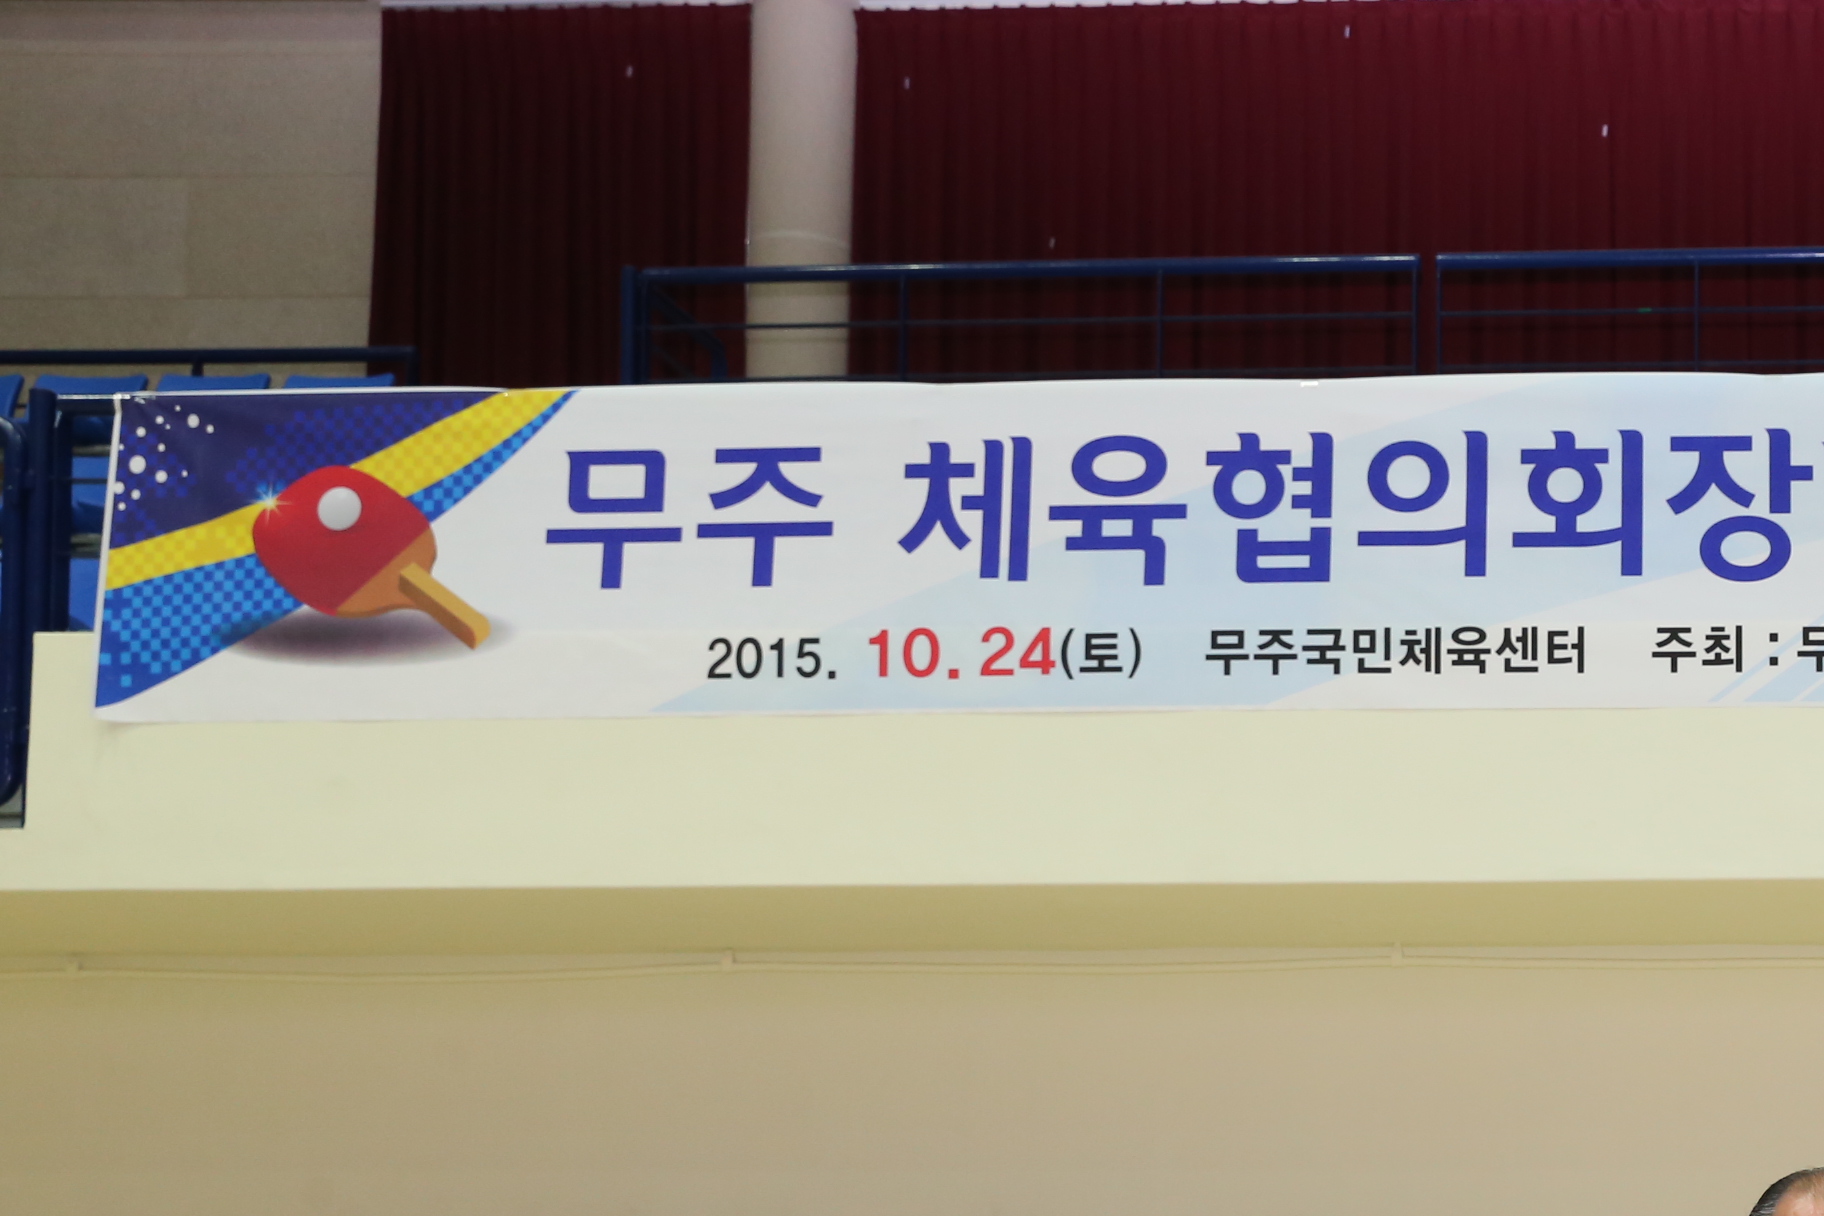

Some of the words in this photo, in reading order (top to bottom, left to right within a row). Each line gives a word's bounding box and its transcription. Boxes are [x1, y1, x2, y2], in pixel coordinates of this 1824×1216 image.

[546, 447, 834, 589] 무주
[706, 636, 838, 680] 2015.
[868, 627, 961, 679] 10.
[979, 626, 1142, 681] 24(토)
[1205, 626, 1586, 676] 무주국민체육센터
